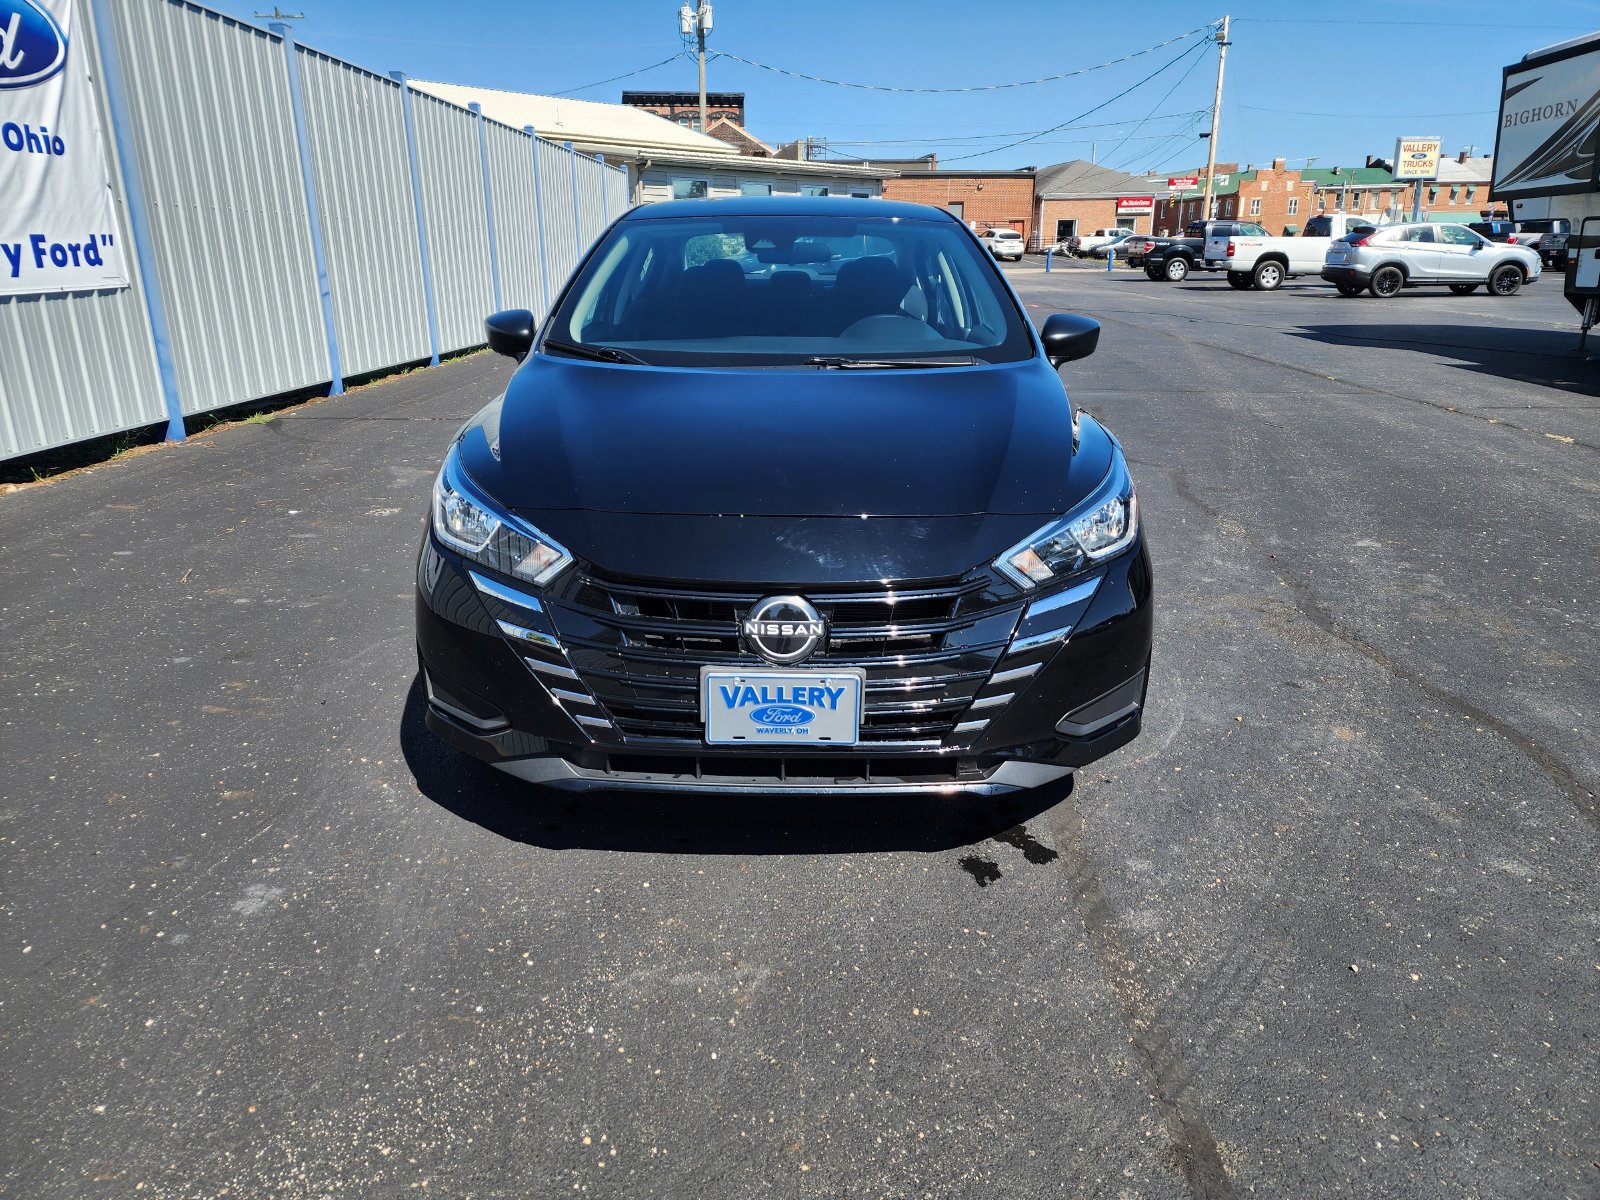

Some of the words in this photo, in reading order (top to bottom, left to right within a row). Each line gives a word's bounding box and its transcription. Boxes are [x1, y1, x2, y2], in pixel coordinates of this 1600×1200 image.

[1503, 98, 1579, 129] BIGHORN
[2, 122, 65, 156] Ohio
[1403, 143, 1438, 153] VALLERY
[1402, 160, 1434, 168] TRUCKS
[745, 623, 823, 636] NISSAN
[720, 685, 847, 711] VALLERY
[762, 707, 802, 723] Ford
[756, 727, 795, 735] WAVERLY,
[796, 727, 809, 735] OH
